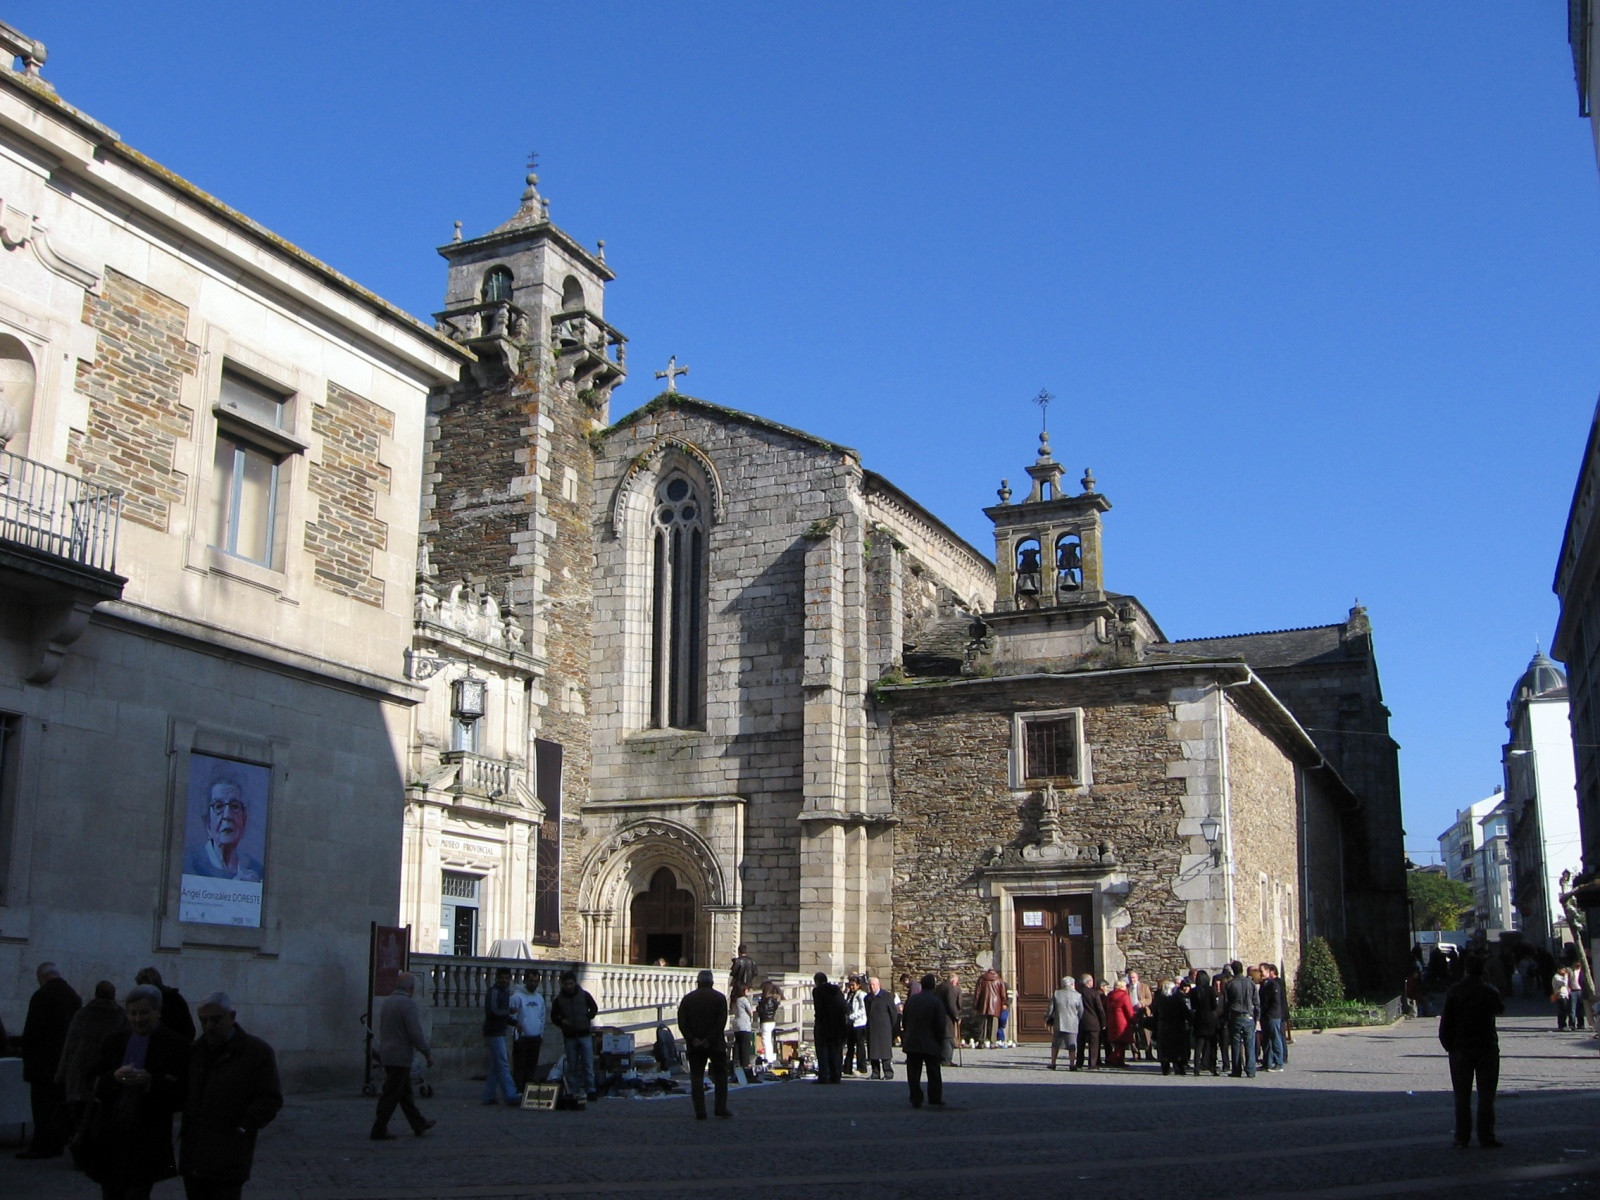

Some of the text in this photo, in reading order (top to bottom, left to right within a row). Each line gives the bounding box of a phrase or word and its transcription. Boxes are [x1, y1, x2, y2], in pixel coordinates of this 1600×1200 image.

[440, 839, 494, 855] MUSEO PROVINCIAL
[232, 893, 261, 904] DORESTE
